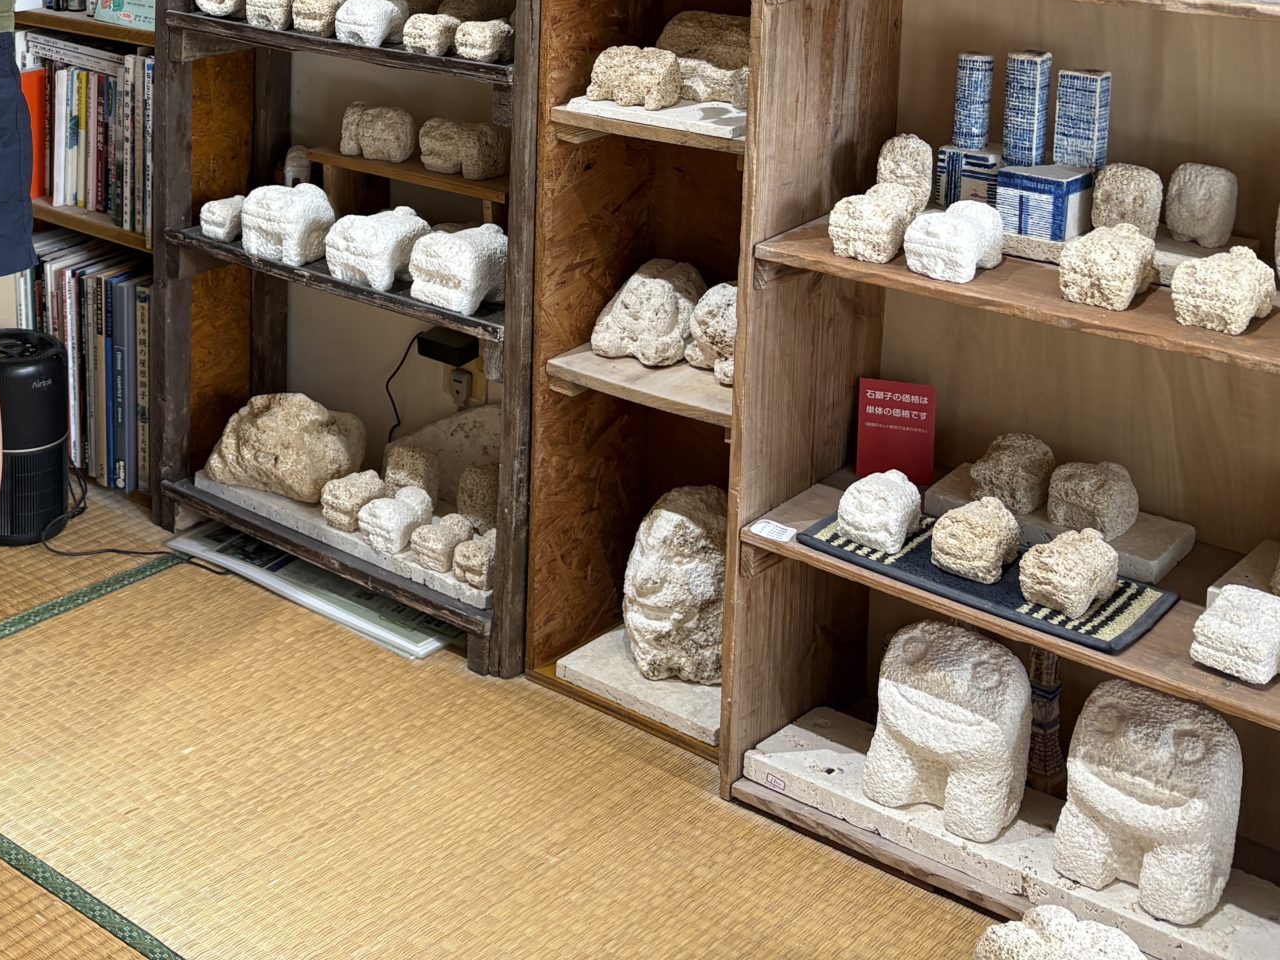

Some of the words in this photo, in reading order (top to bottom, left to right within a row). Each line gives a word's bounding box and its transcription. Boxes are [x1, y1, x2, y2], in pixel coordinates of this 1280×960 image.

[866, 389, 928, 404] 石獅子の価格は
[866, 405, 927, 420] 単体の価格です
